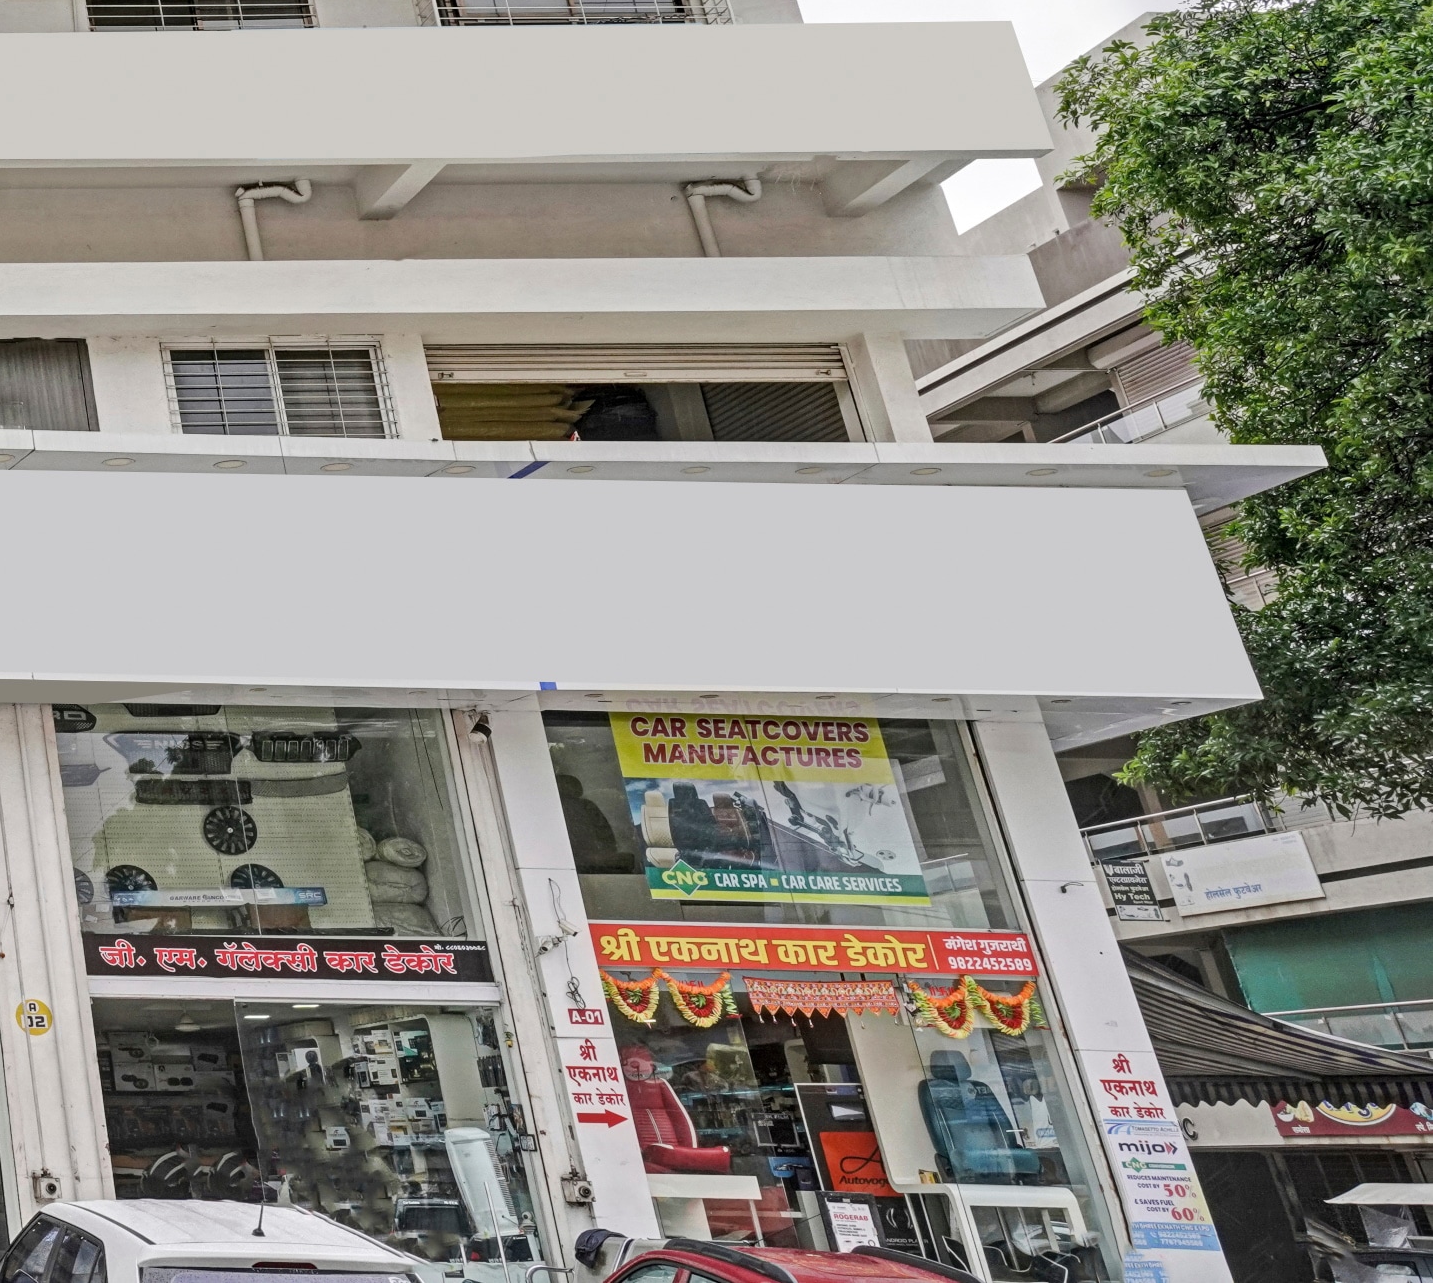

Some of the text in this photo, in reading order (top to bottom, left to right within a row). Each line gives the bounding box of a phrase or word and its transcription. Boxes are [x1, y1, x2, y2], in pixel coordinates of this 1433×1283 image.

[631, 717, 870, 743] CAR SEATCOVERS
[643, 742, 863, 768] MANUFACTURES
[661, 868, 708, 886] CNG
[715, 873, 768, 889] CAR SPA
[781, 874, 903, 893] CAR CARE SERVICES
[1114, 893, 1127, 901] Hy
[1204, 887, 1232, 900] होलसेल
[599, 927, 930, 969] श्री एकनाथ कार डेकोर
[942, 935, 1027, 956] मंगेश गुजराथी
[99, 939, 458, 976] जी. एम. गॅलेक्सी कार डेकोर
[948, 955, 1033, 972] 9822452589
[28, 1002, 37, 1012] A
[572, 1011, 603, 1023] A-01
[579, 1038, 597, 1061] श्री
[1112, 1053, 1132, 1074] श्री
[565, 1066, 619, 1087] एकनाथ
[572, 1088, 626, 1106] कार डेकोर
[1099, 1079, 1158, 1101] एकनाथ
[1108, 1102, 1167, 1119] कार डेकोर
[1118, 1140, 1166, 1155] mijo
[1125, 1161, 1147, 1169] CNG
